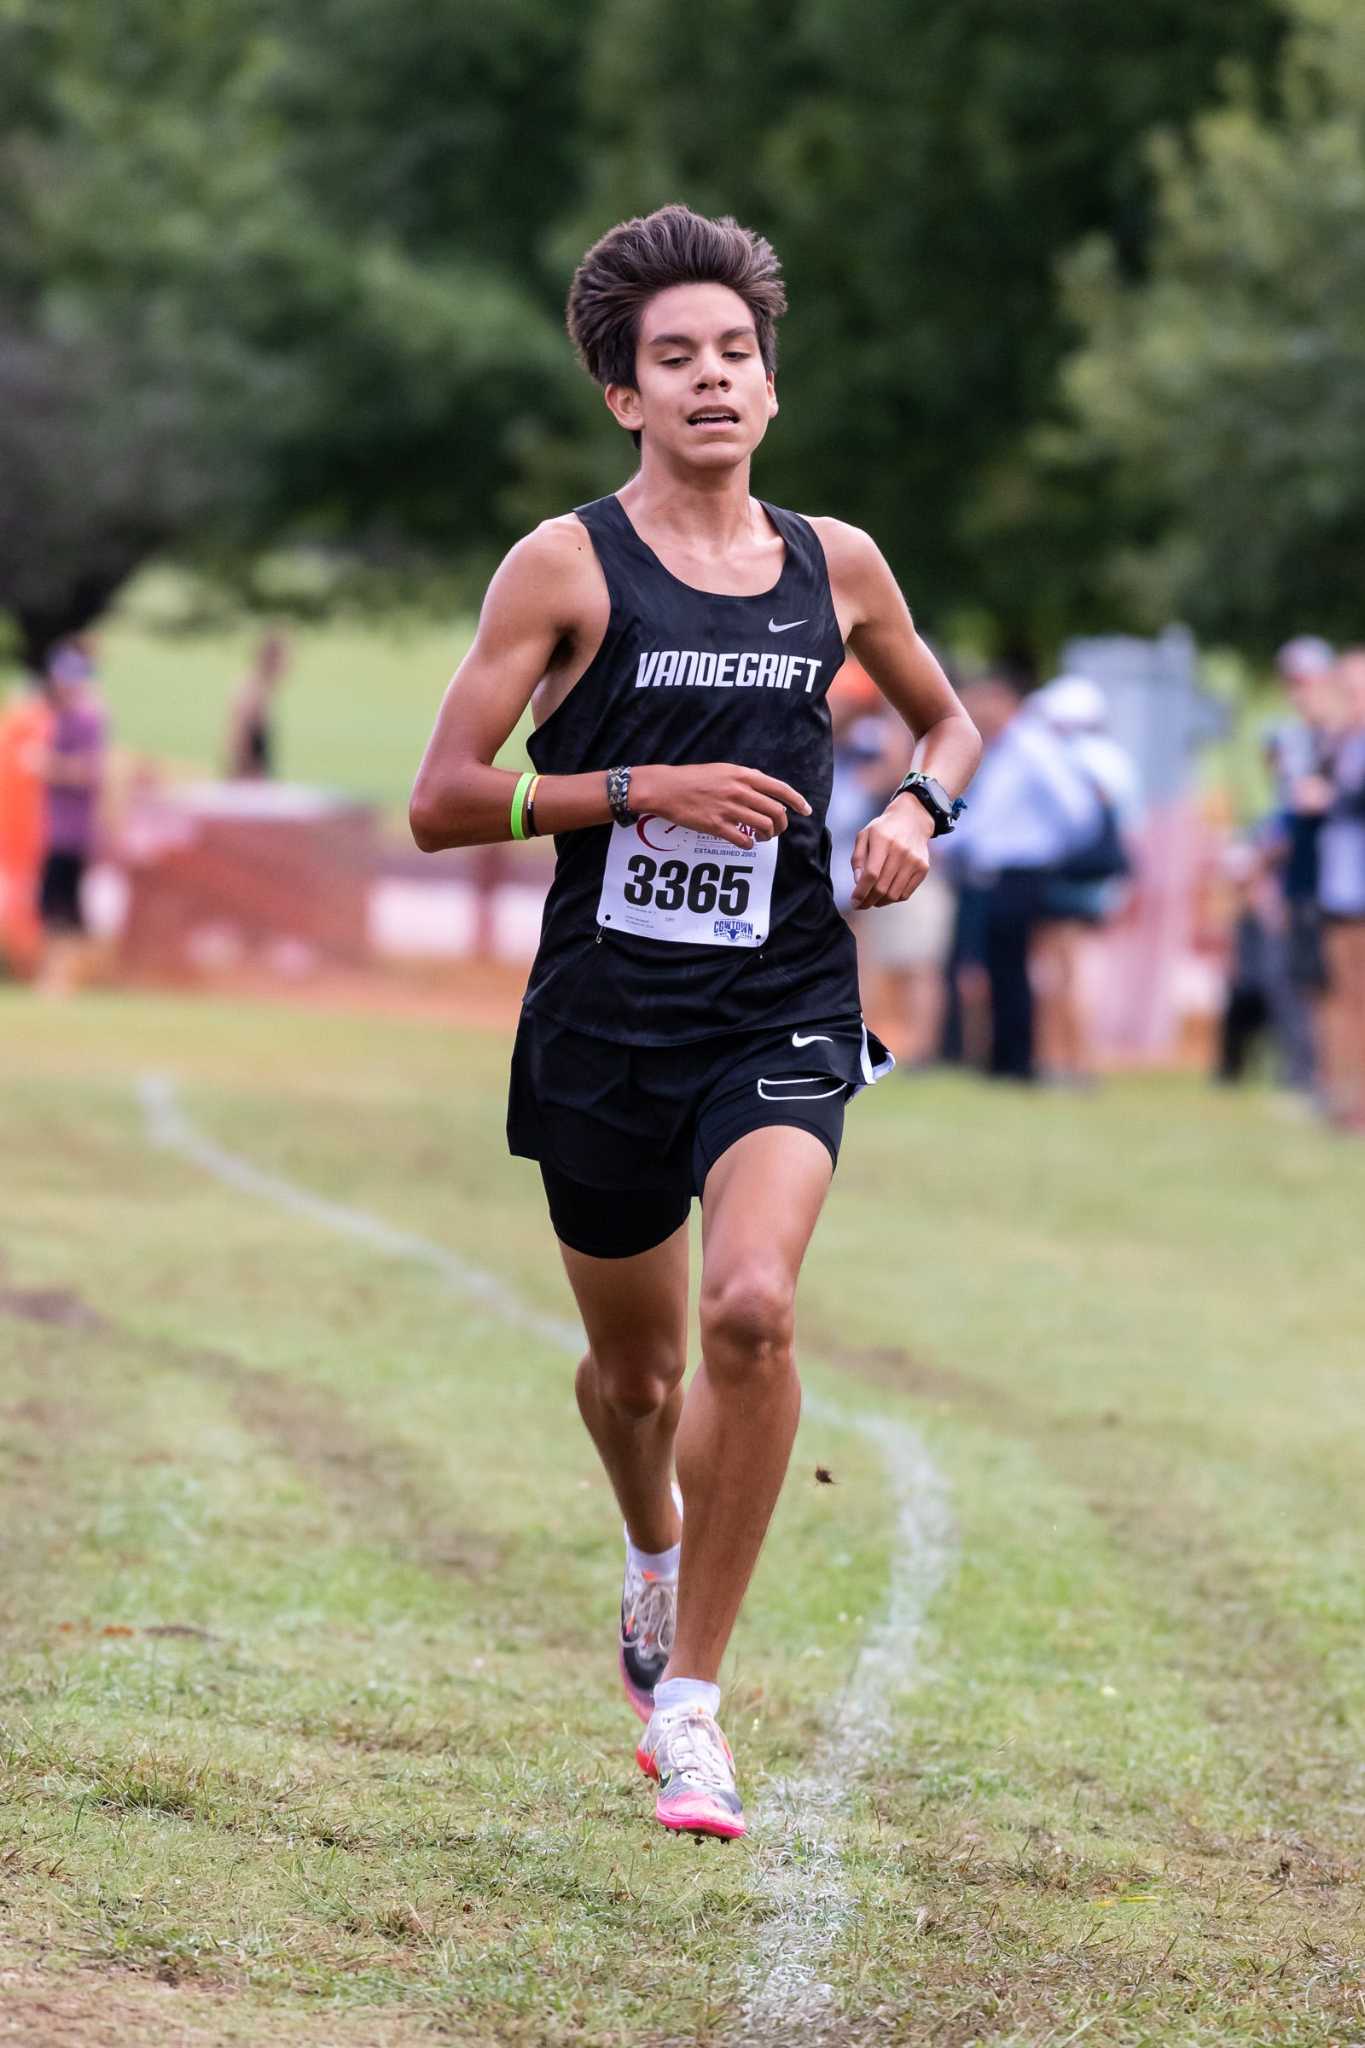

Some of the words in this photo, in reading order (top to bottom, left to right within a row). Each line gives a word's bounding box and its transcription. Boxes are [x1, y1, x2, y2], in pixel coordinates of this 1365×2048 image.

[635, 651, 822, 693] VANDEGRIFT
[694, 848, 740, 857] ESTABLISHED
[624, 855, 753, 917] 3365
[713, 920, 753, 936] COWTOWN
